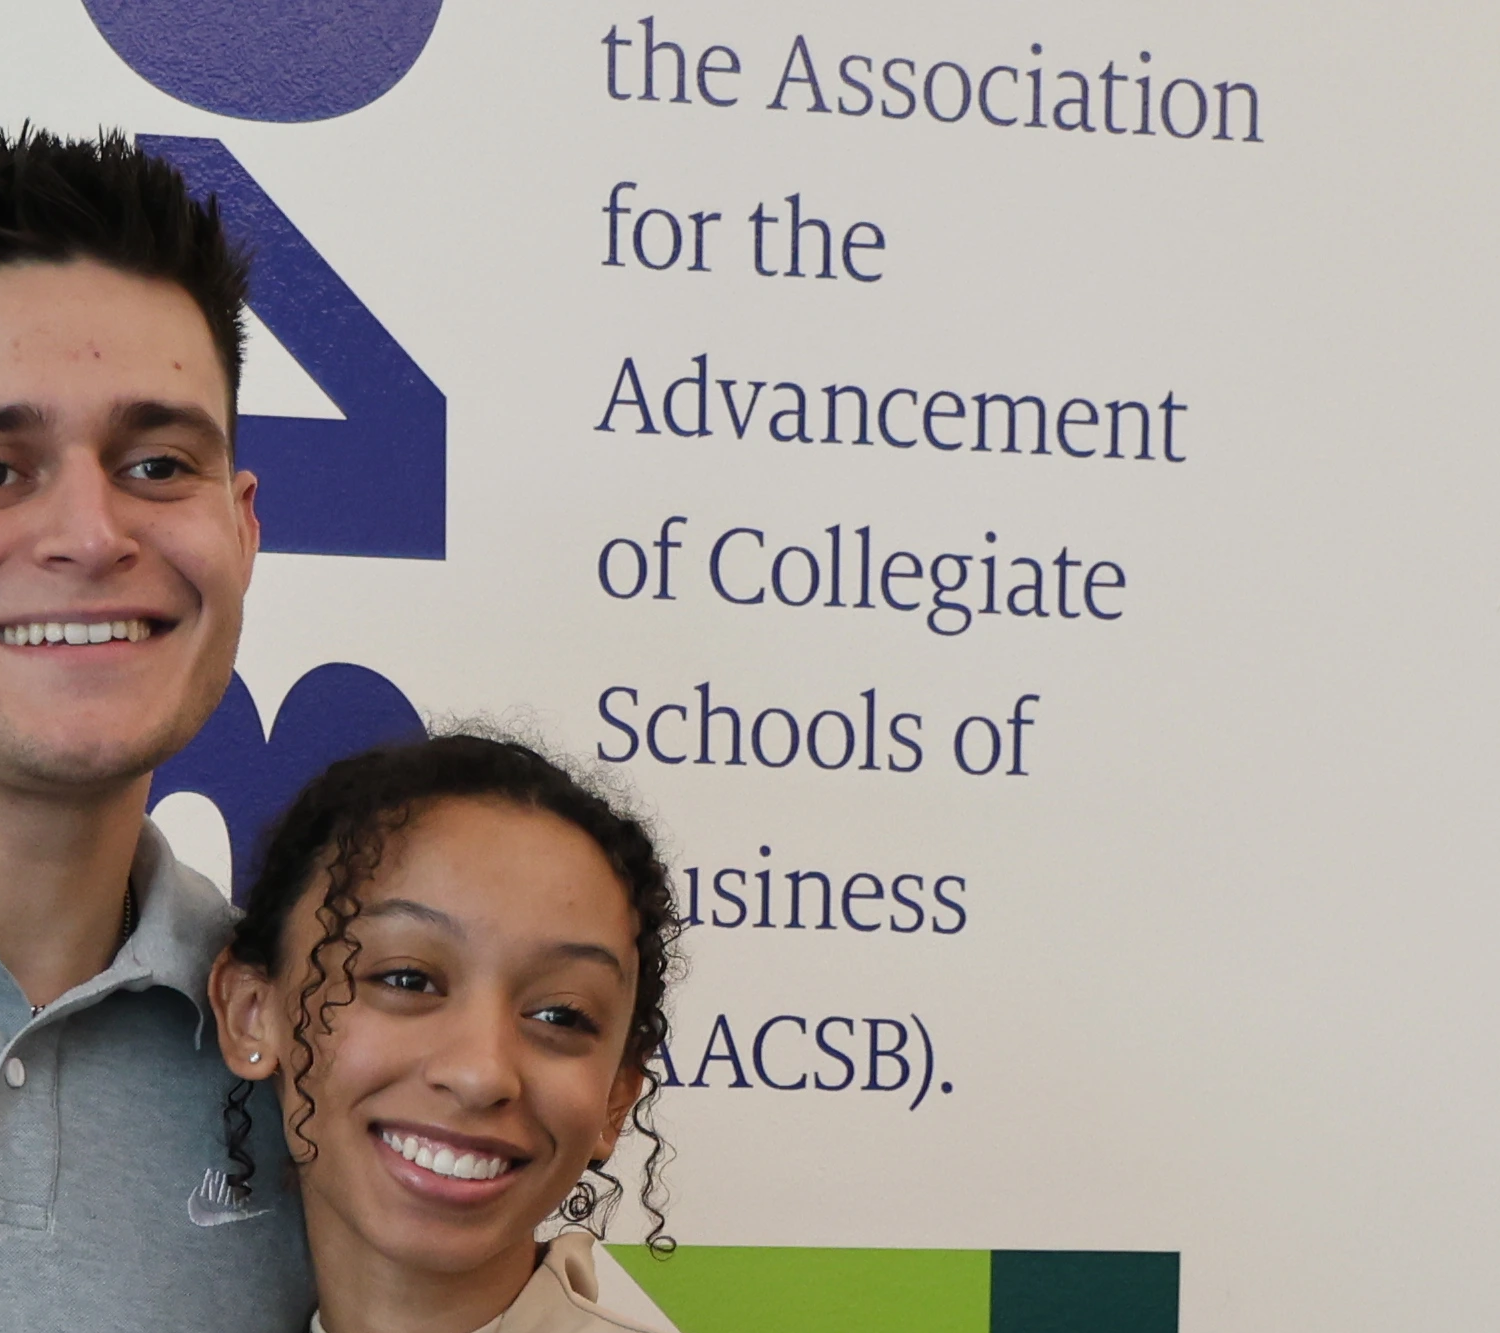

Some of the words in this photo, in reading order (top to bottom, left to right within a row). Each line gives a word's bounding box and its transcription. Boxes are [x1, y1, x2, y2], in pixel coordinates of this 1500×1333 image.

[601, 15, 741, 108] the
[766, 34, 1264, 143] Association
[601, 181, 722, 272] for
[748, 192, 886, 283] the
[593, 353, 1188, 463] Advancement
[598, 515, 688, 601] of
[709, 523, 1126, 637] Collegiate
[597, 680, 923, 773] Schools
[954, 693, 1041, 776] of
[680, 844, 968, 936] usiness
[655, 1012, 955, 1112] AACSB).
